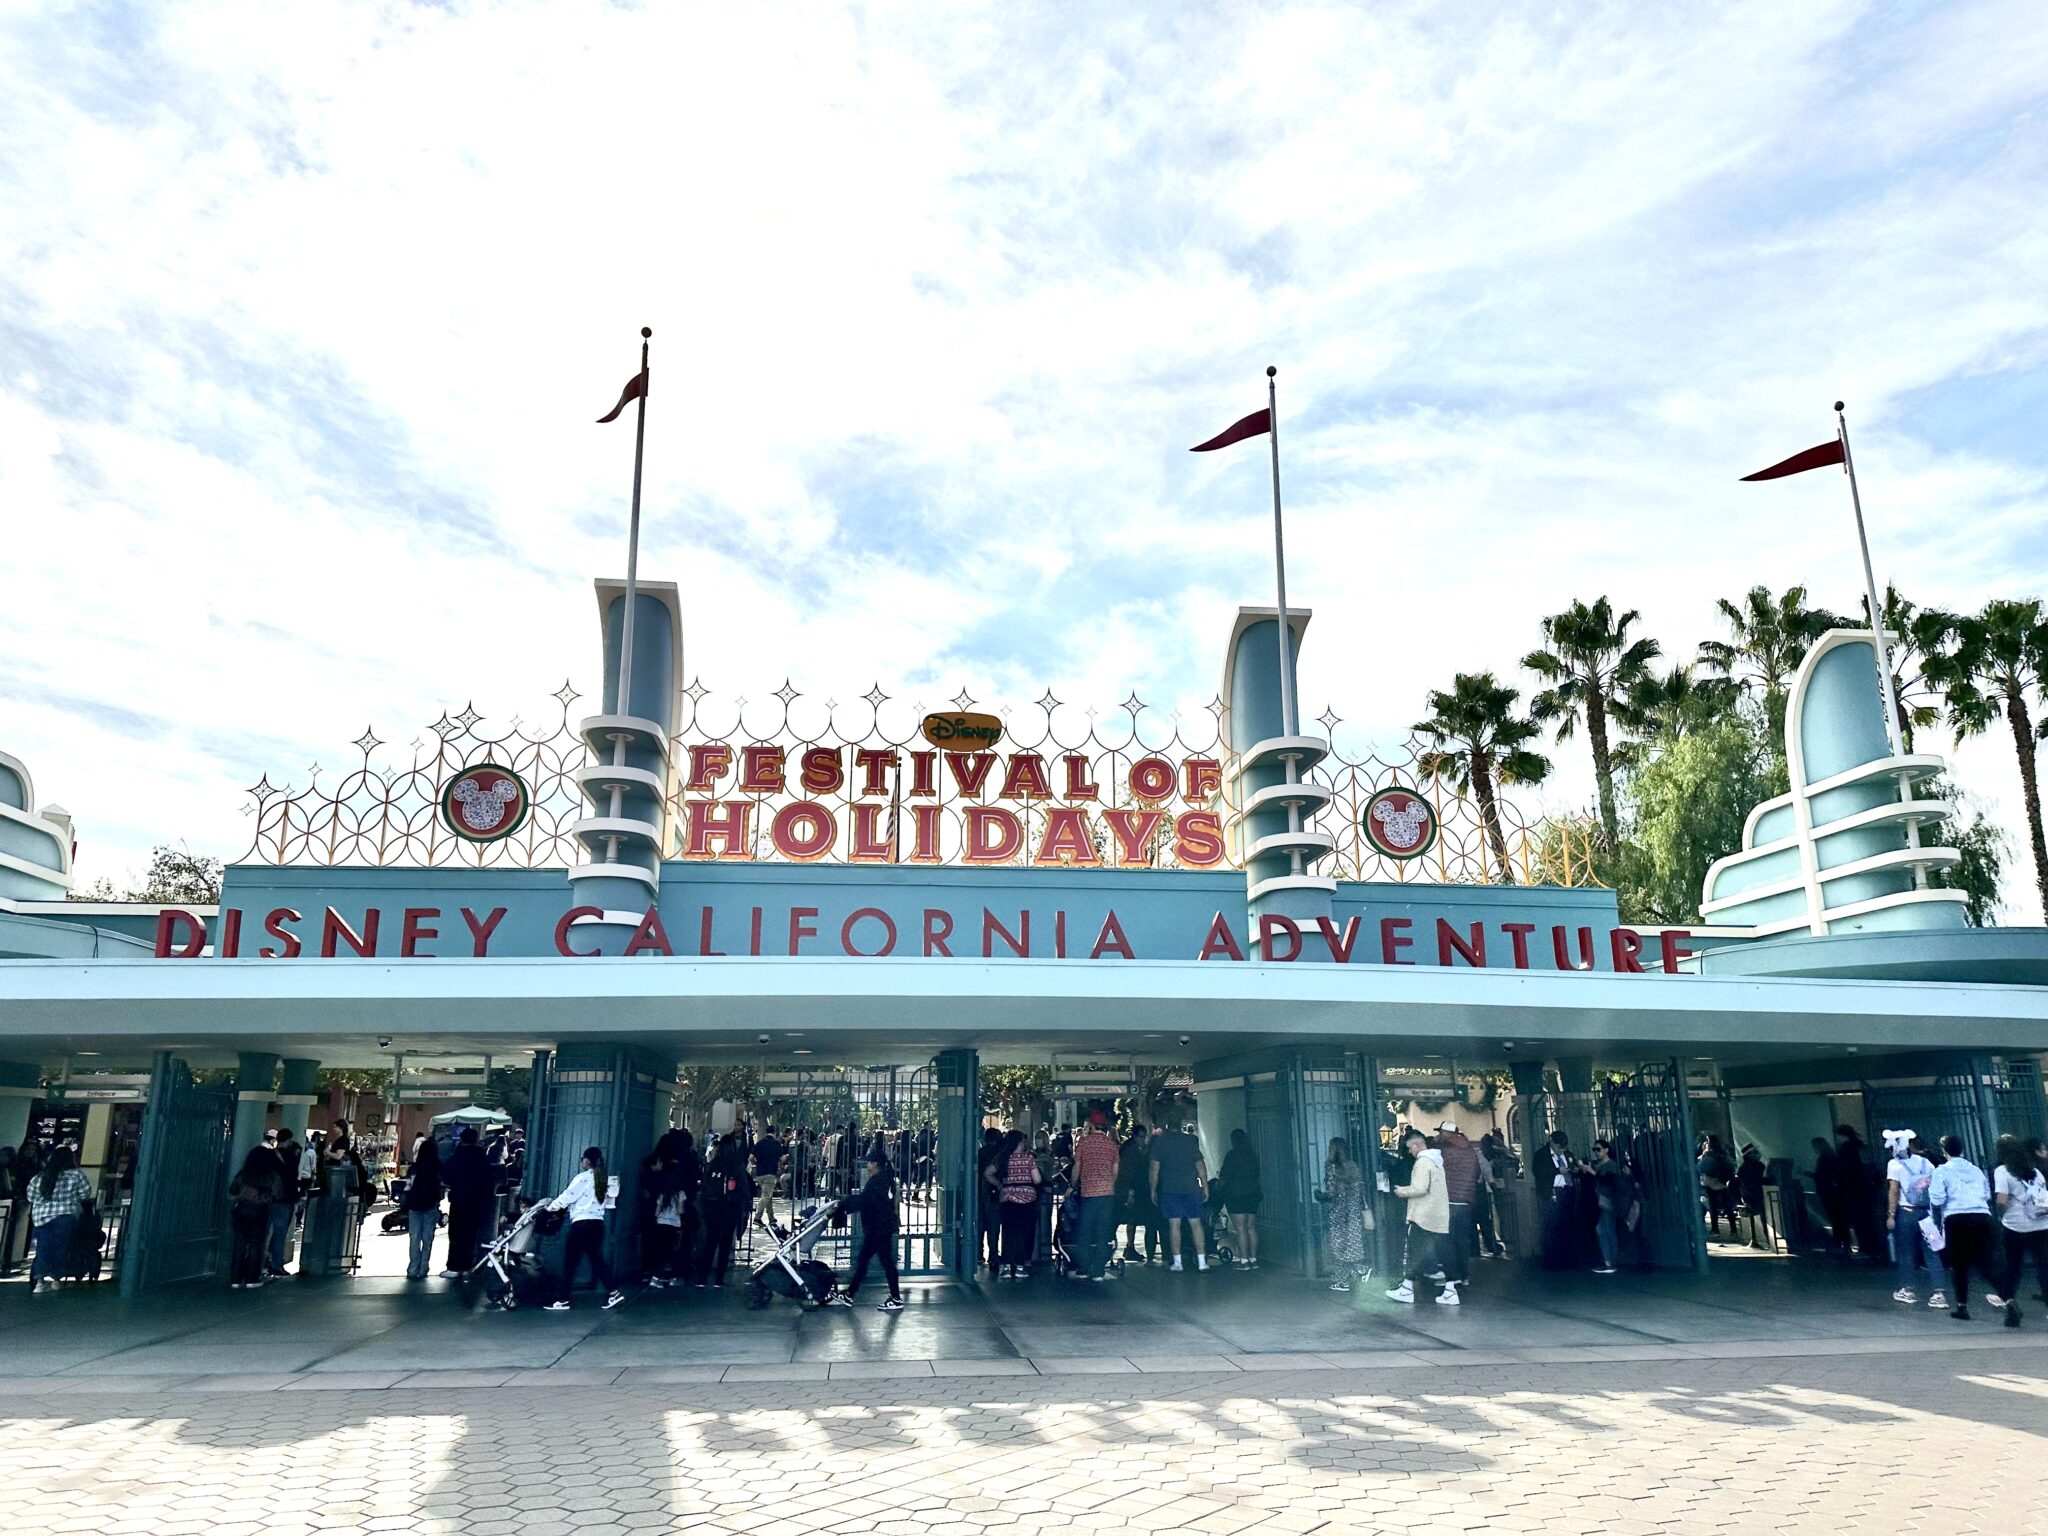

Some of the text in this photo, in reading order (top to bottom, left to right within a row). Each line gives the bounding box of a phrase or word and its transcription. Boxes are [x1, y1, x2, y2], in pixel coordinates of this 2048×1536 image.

[925, 714, 1001, 747] Disney
[686, 744, 1222, 803] FESTIVAL OF
[681, 800, 1226, 870] HOLIDAYS
[154, 904, 1696, 975] DISNEY CALIFORNIA ADVENTURE
